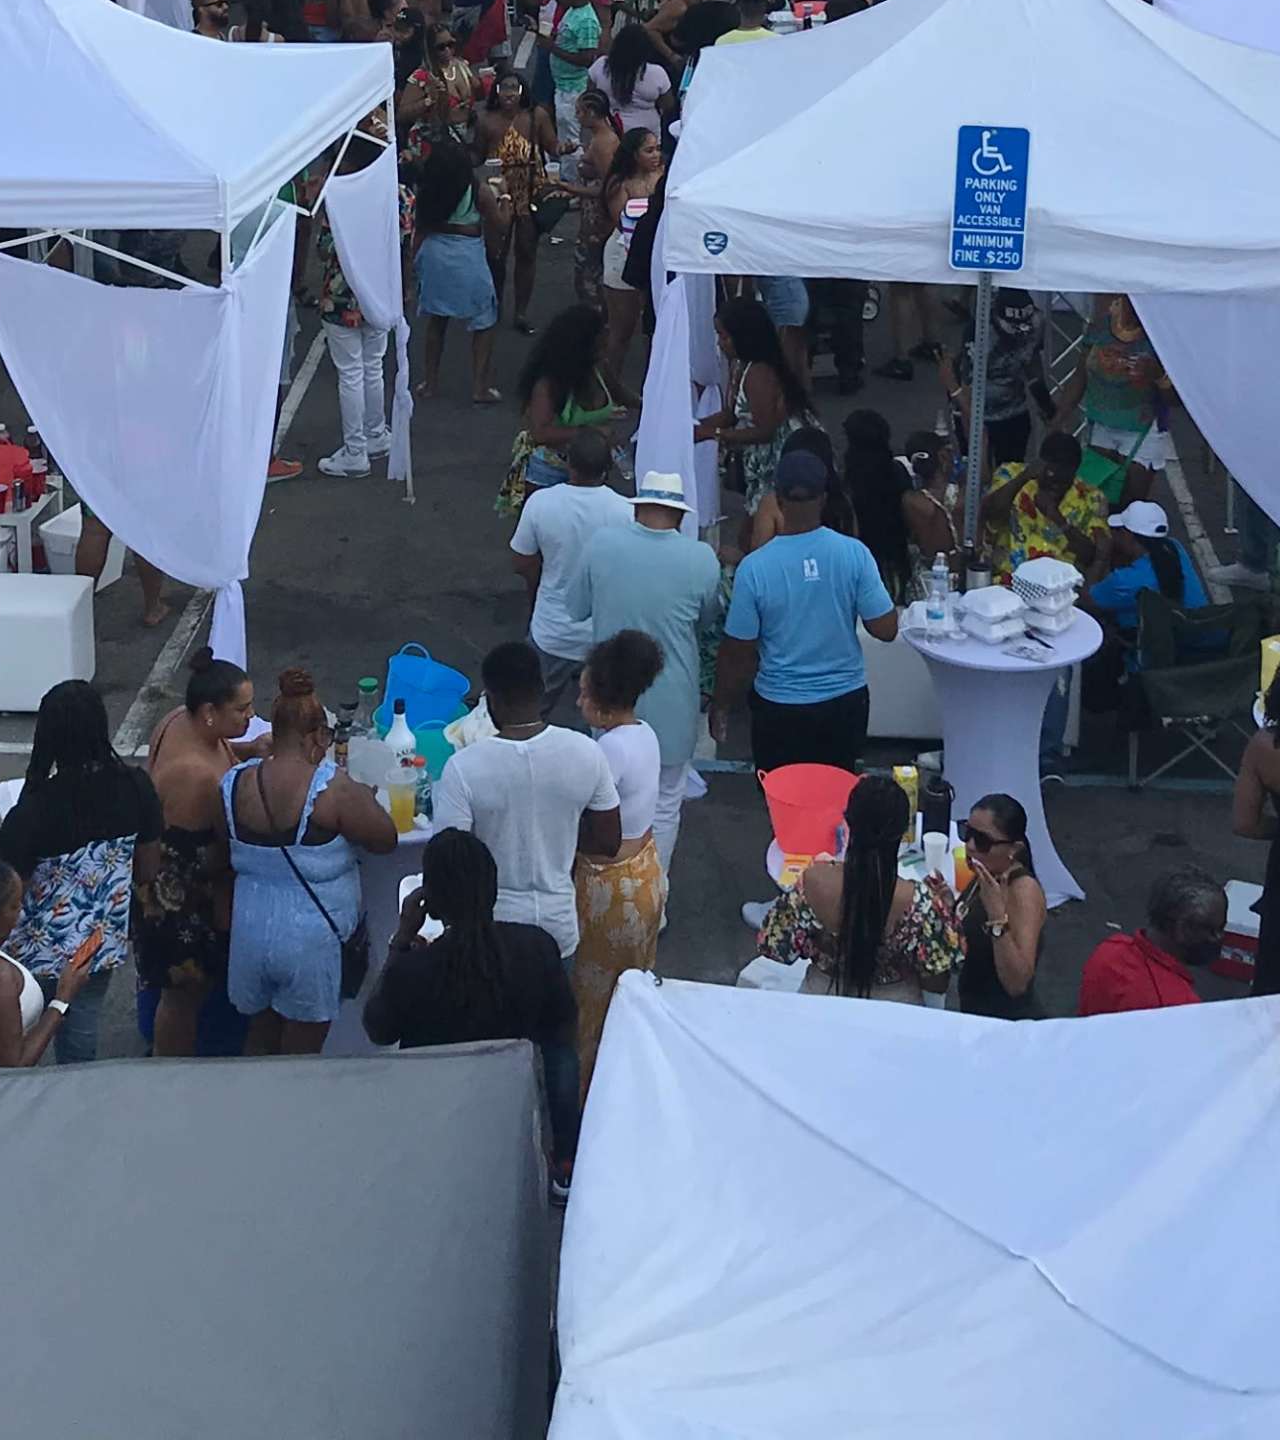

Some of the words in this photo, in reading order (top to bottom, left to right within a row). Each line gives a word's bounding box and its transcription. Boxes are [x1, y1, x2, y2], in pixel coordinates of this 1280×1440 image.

[965, 178, 1018, 191] PARKING
[974, 191, 1006, 204] ONLY
[979, 204, 1001, 215] VAN
[957, 215, 1022, 228] ACCESSIBLE
[962, 234, 1014, 249] MINIMUM
[954, 249, 981, 263] FINE
[986, 250, 1020, 265] $250
